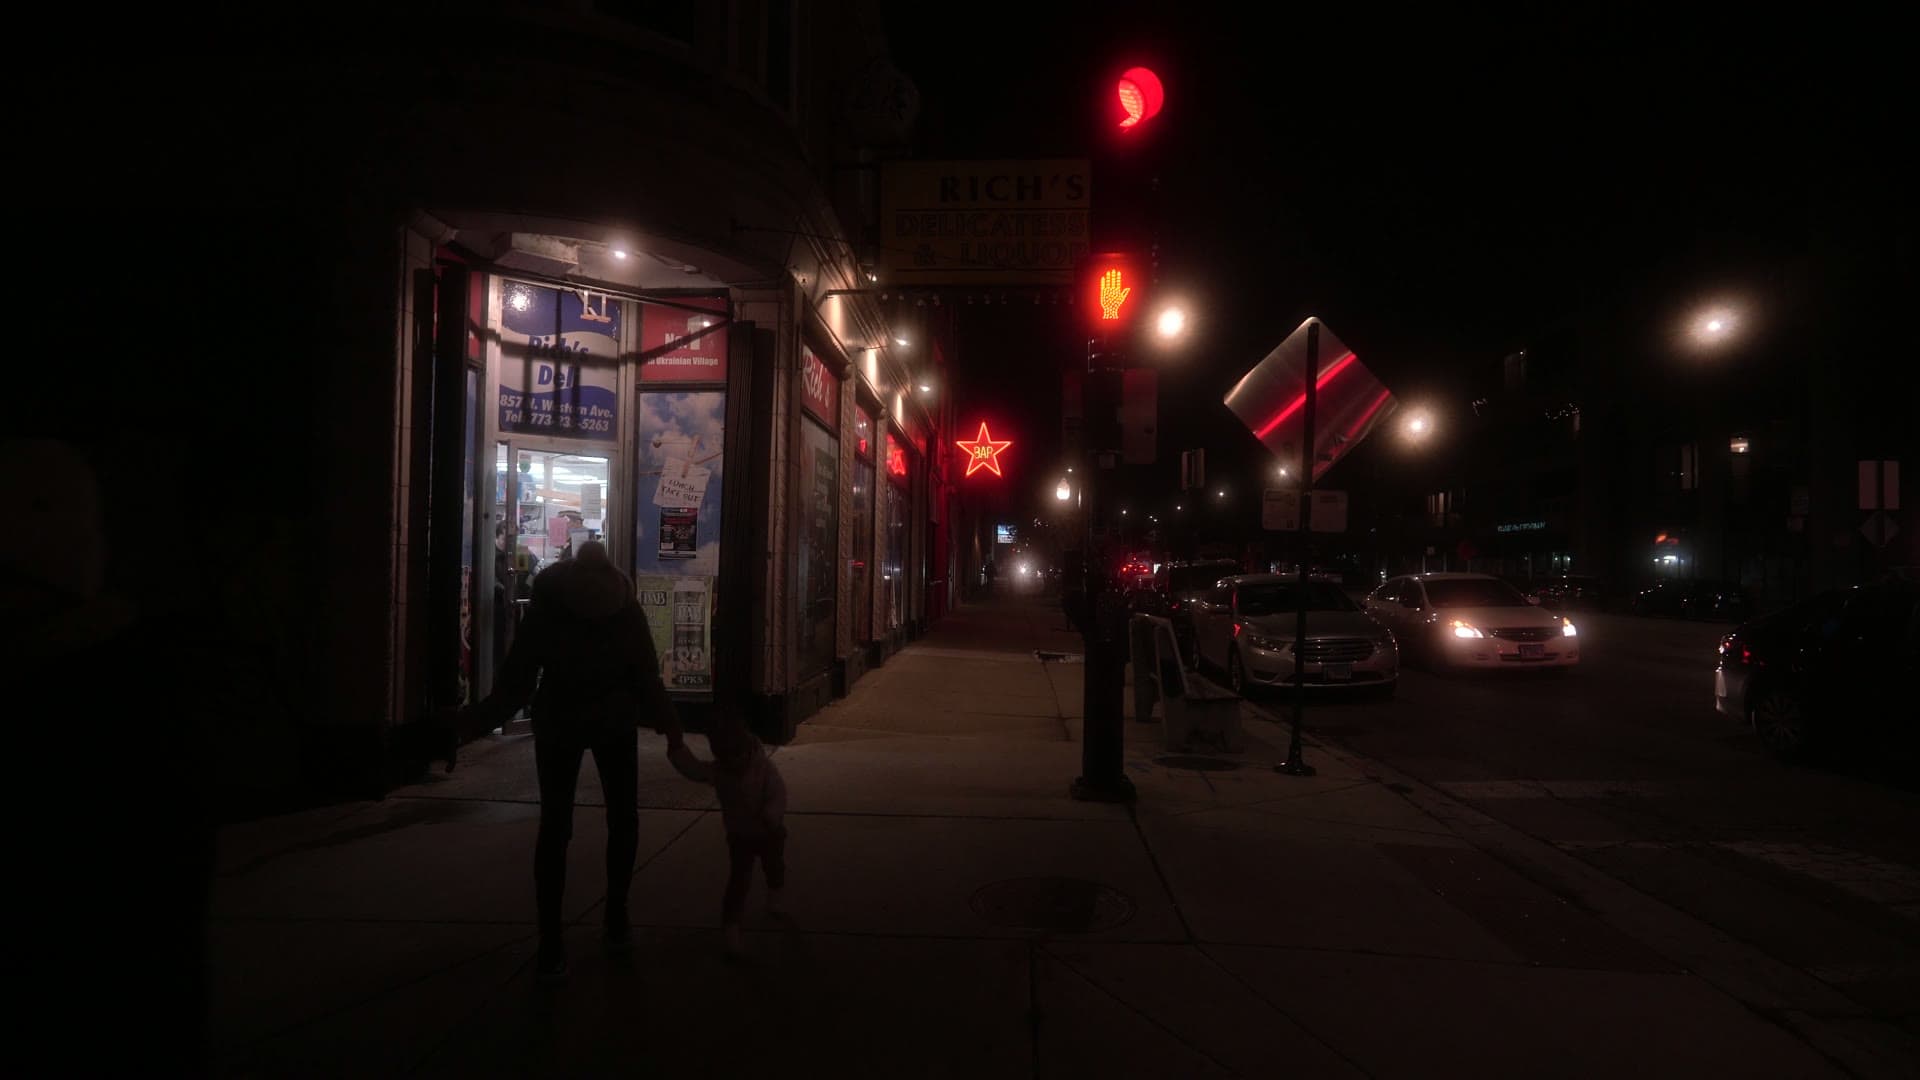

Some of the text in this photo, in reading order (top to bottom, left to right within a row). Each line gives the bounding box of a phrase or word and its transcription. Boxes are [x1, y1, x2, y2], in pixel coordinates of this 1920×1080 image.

[940, 174, 1085, 202] RICH'S
[692, 356, 720, 368] Village
[500, 394, 523, 408] 857
[590, 404, 614, 418] Ave.
